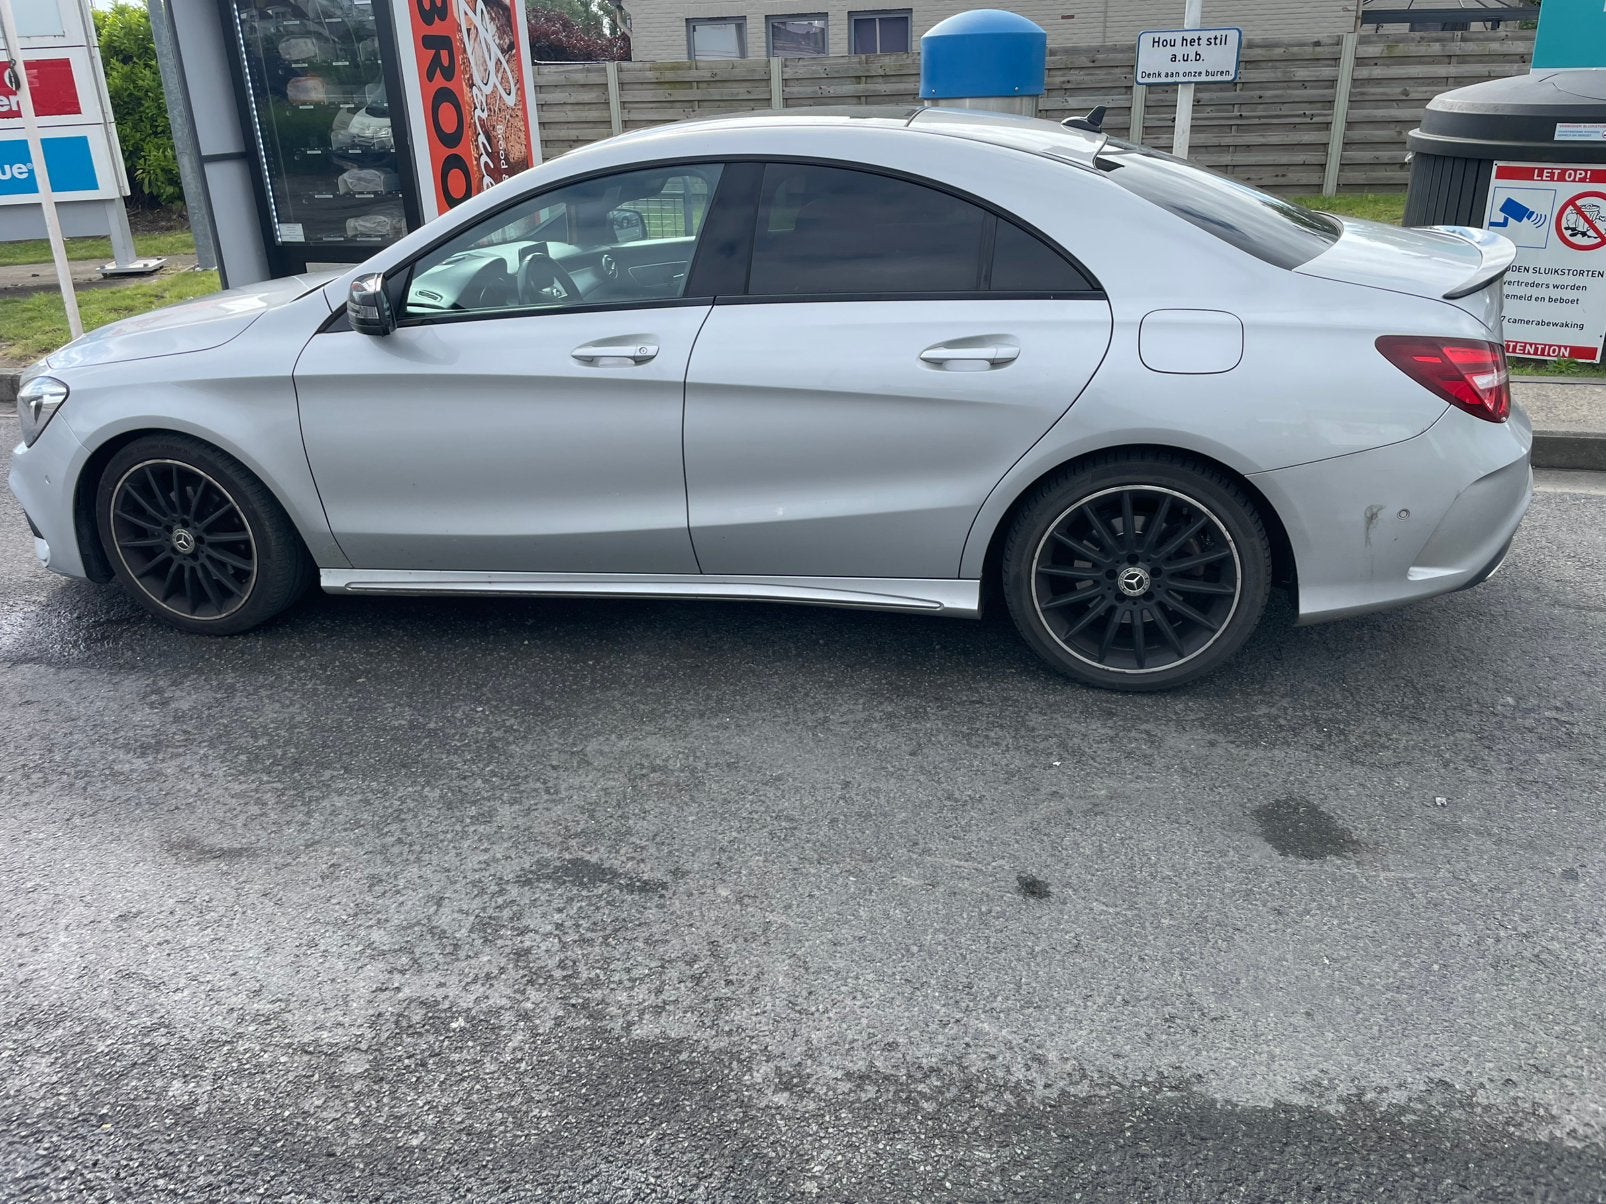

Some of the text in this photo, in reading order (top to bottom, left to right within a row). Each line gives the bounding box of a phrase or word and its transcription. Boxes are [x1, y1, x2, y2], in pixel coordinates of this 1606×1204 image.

[1152, 34, 1228, 48] Hou het stil
[1170, 51, 1205, 62] a.u.b.
[1141, 71, 1162, 79] Denk
[1182, 70, 1202, 78] onze
[1205, 69, 1233, 77] buren.
[1534, 168, 1591, 182] LET OP!
[1532, 266, 1605, 278] SLUIKSTORTEN
[1552, 283, 1587, 292] worden
[1548, 295, 1580, 305] beboet
[1507, 317, 1585, 330] camerabewaking
